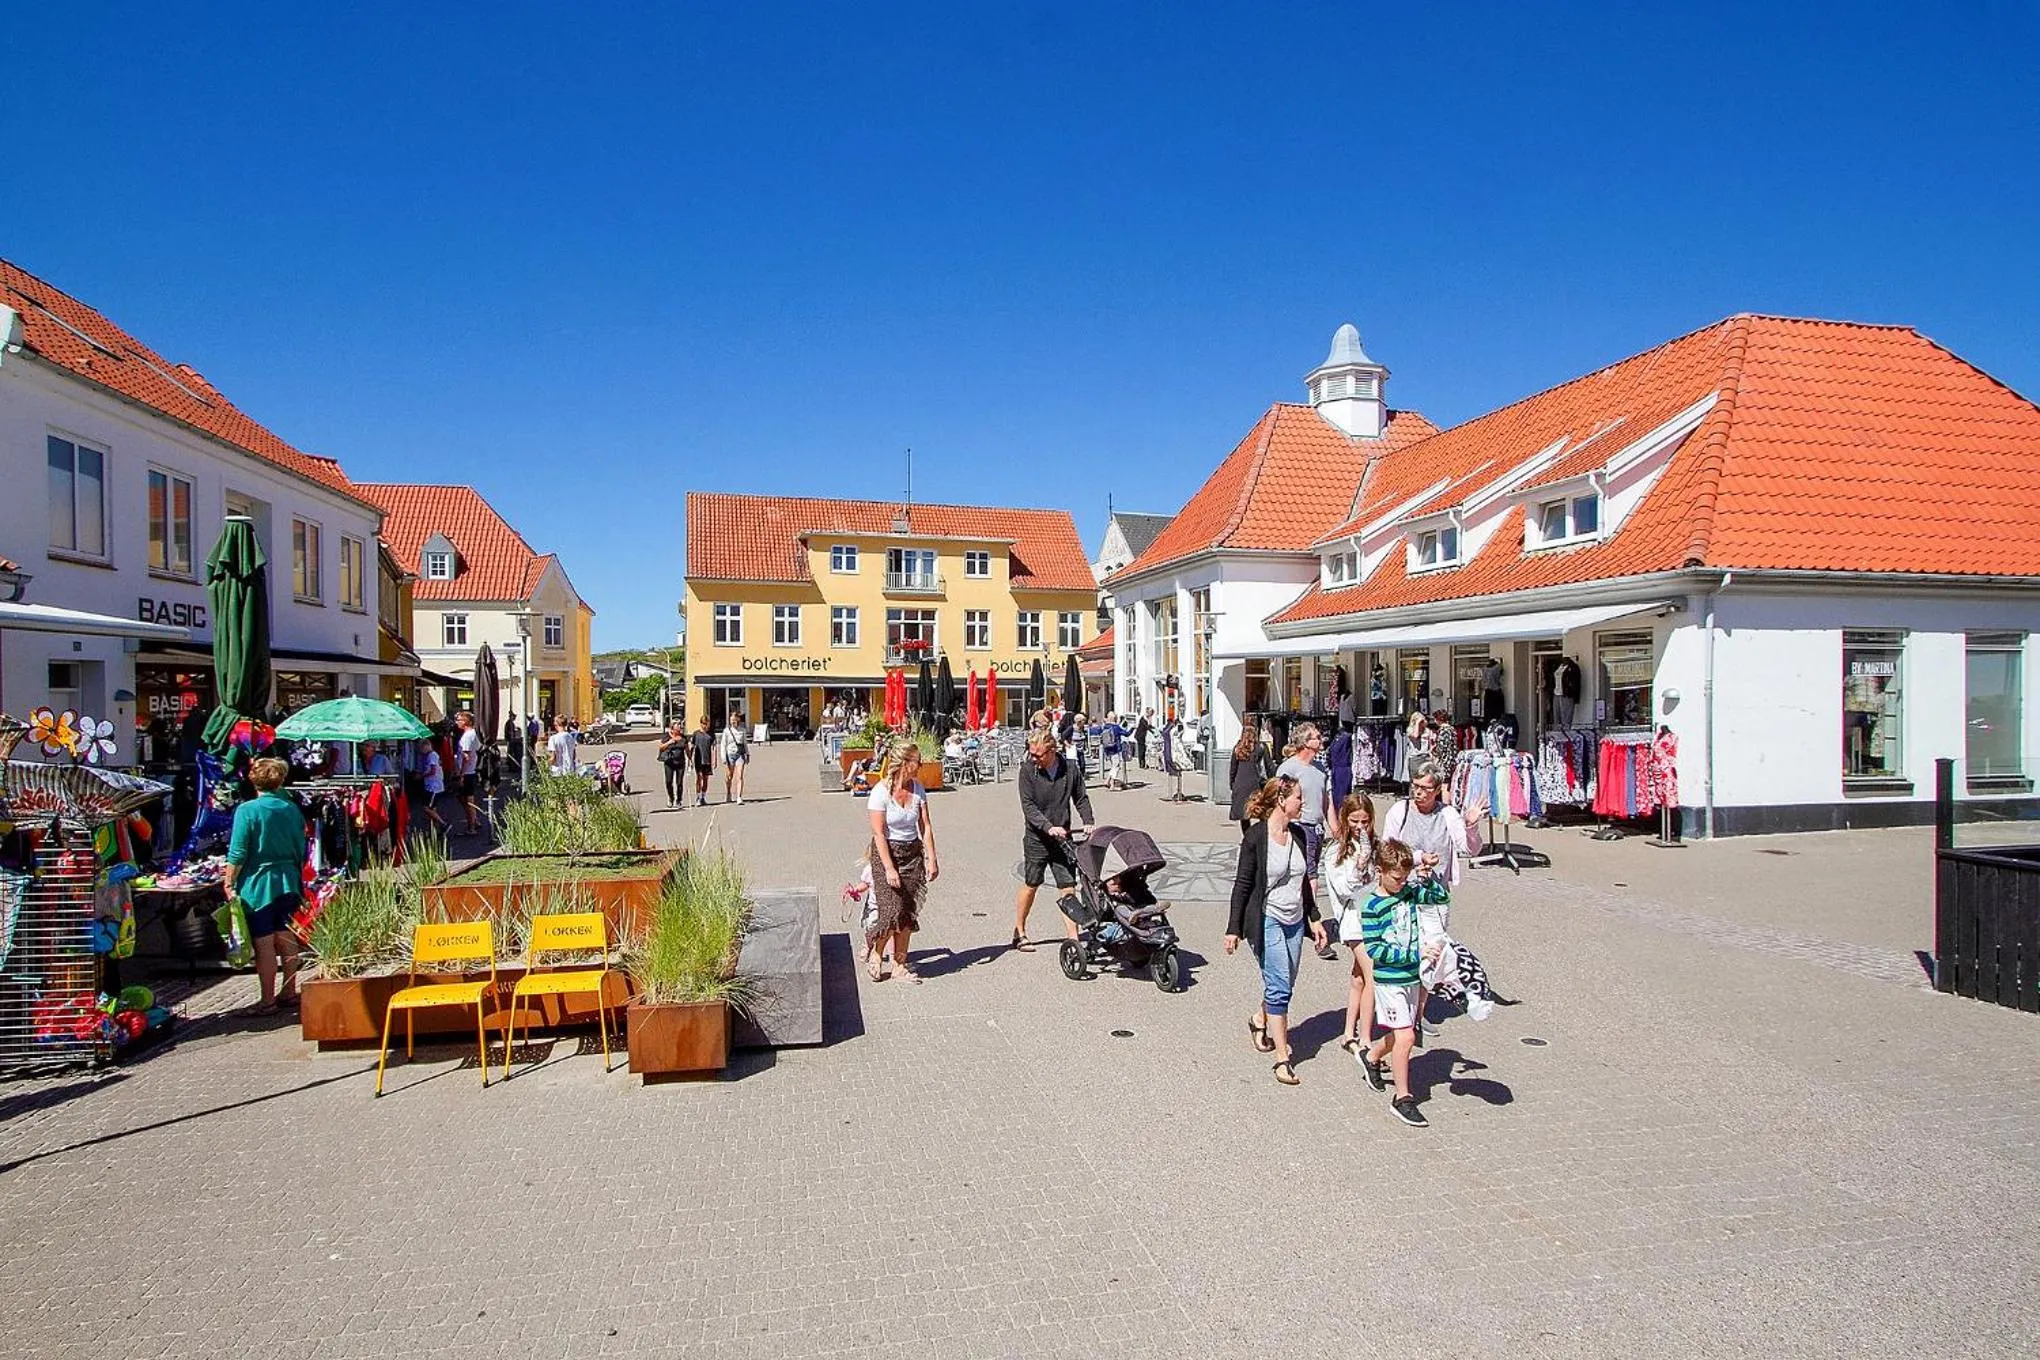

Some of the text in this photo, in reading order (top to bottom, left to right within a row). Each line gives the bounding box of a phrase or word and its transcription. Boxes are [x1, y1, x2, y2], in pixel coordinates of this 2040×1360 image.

[138, 597, 206, 628] BASIC
[742, 656, 828, 671] bolcheriet
[990, 658, 1066, 673] bolchriet
[1851, 661, 1862, 674] BY
[148, 694, 194, 712] BASIC
